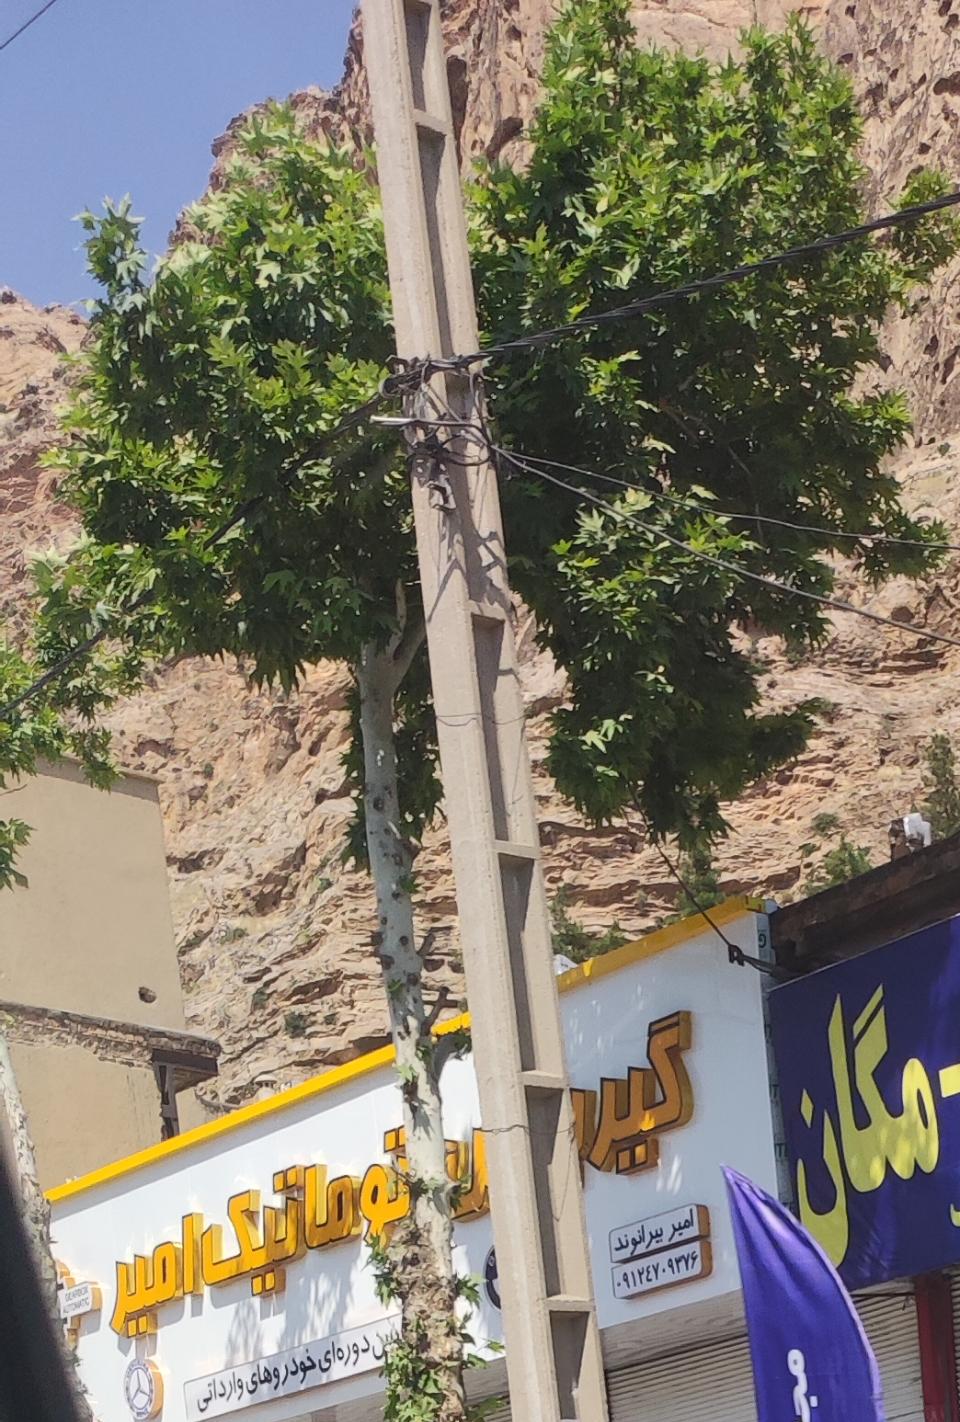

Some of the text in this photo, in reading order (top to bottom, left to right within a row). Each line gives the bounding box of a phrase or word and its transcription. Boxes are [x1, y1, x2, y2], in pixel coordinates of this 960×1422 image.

[613, 1207, 694, 1256] امیر بیرانوند
[108, 1211, 206, 1340] امیر
[197, 1371, 245, 1413] وارداتی
